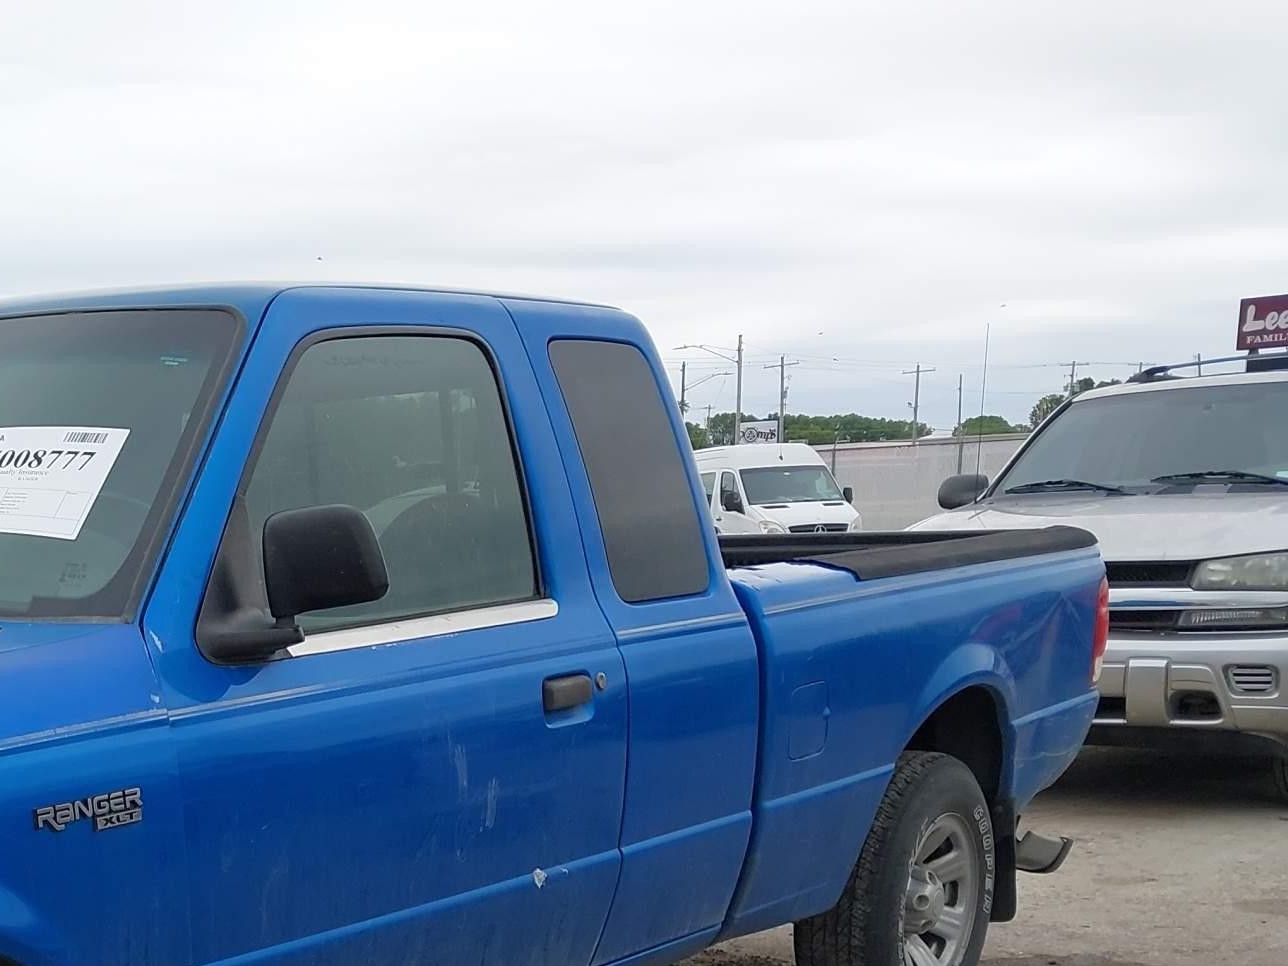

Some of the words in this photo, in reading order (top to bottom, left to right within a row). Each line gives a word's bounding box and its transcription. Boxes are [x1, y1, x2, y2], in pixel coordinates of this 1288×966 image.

[1246, 333, 1288, 344] FAMIL
[36, 787, 143, 831] RANGER
[101, 811, 138, 827] XLT
